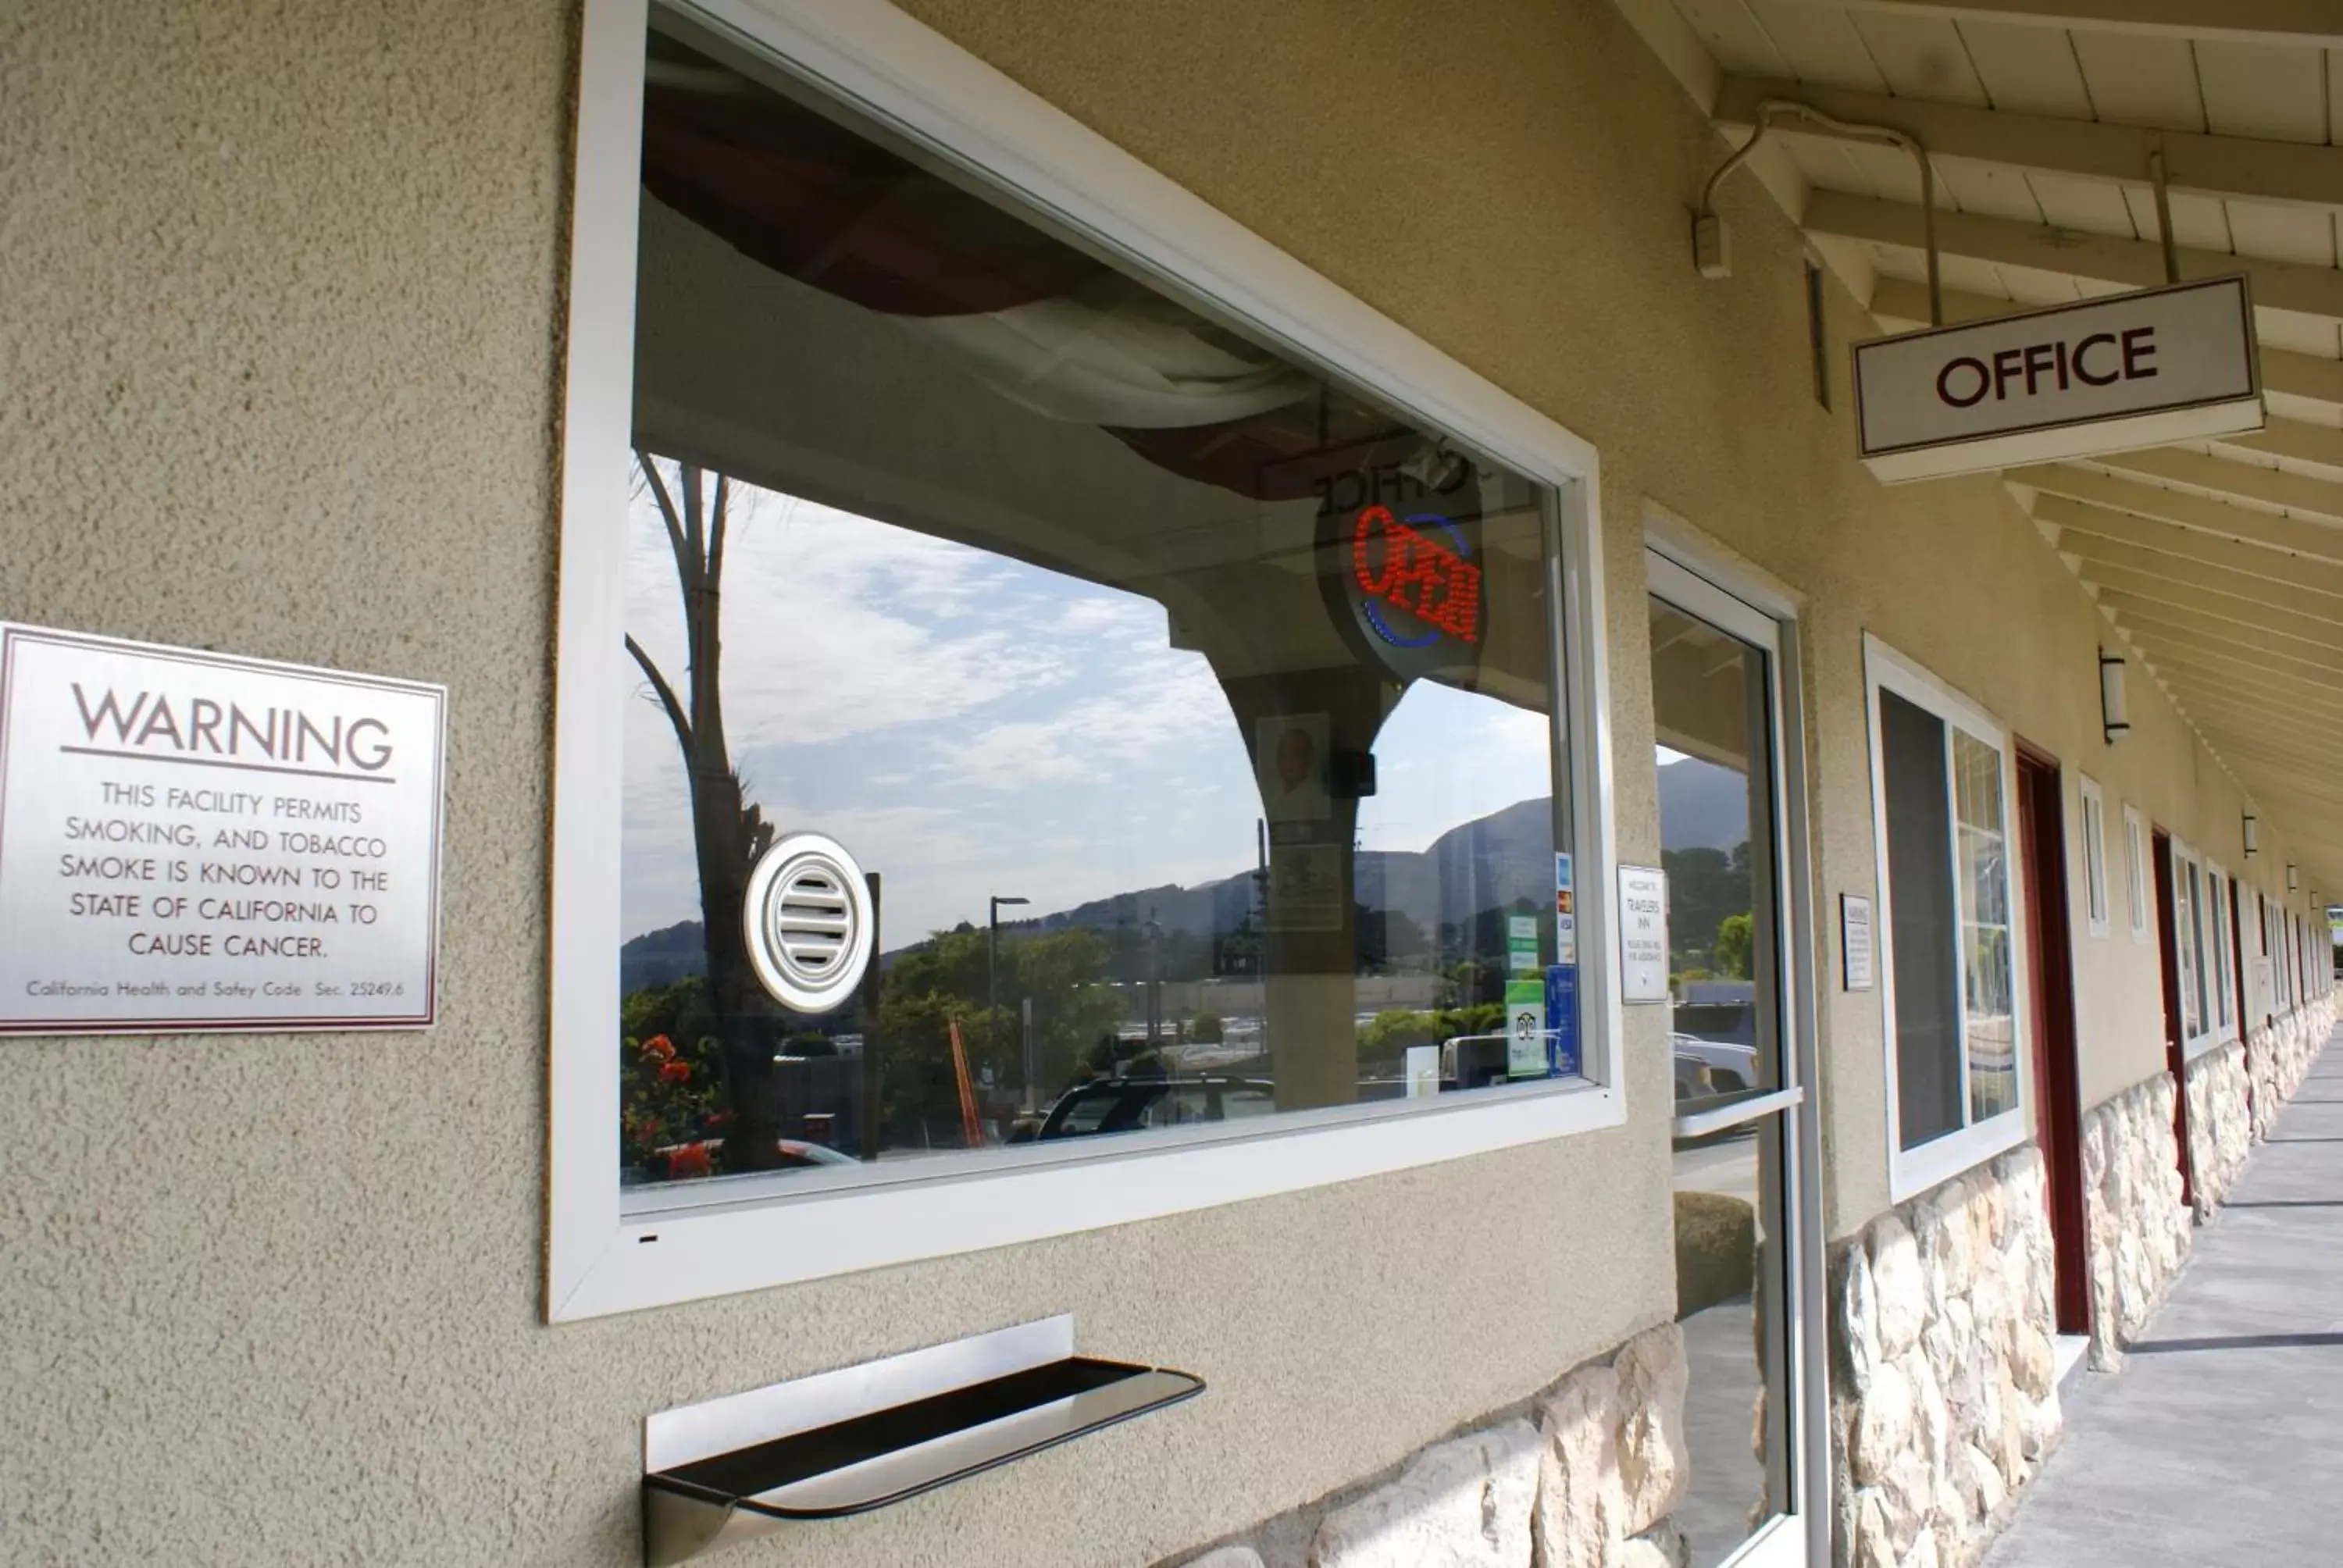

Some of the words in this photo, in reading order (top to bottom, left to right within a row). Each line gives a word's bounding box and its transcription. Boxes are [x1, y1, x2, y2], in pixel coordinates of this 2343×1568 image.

[1936, 326, 2158, 408] OFFICE
[1353, 504, 1480, 642] OPEN
[70, 682, 394, 771] WARNING
[101, 782, 155, 807] THIS
[167, 788, 263, 815] FACILITY
[273, 796, 362, 824] PERMITS
[65, 816, 201, 850] SMOKING,
[213, 829, 269, 851] AND
[279, 832, 387, 858] TOBACCO
[59, 854, 156, 880] SMOKE
[167, 861, 188, 882] IS
[200, 863, 301, 886] KNOWN
[312, 868, 341, 889] TO
[351, 871, 388, 891] THE
[70, 893, 140, 917] STATE
[153, 896, 188, 918] OF
[198, 899, 338, 923] CALIFORNIA
[350, 904, 377, 925] TO
[127, 933, 212, 957] CAUSE
[223, 935, 329, 958] CANCER.
[26, 980, 109, 996] California
[117, 981, 169, 996] Health
[177, 982, 206, 996] and
[262, 982, 302, 996] Code
